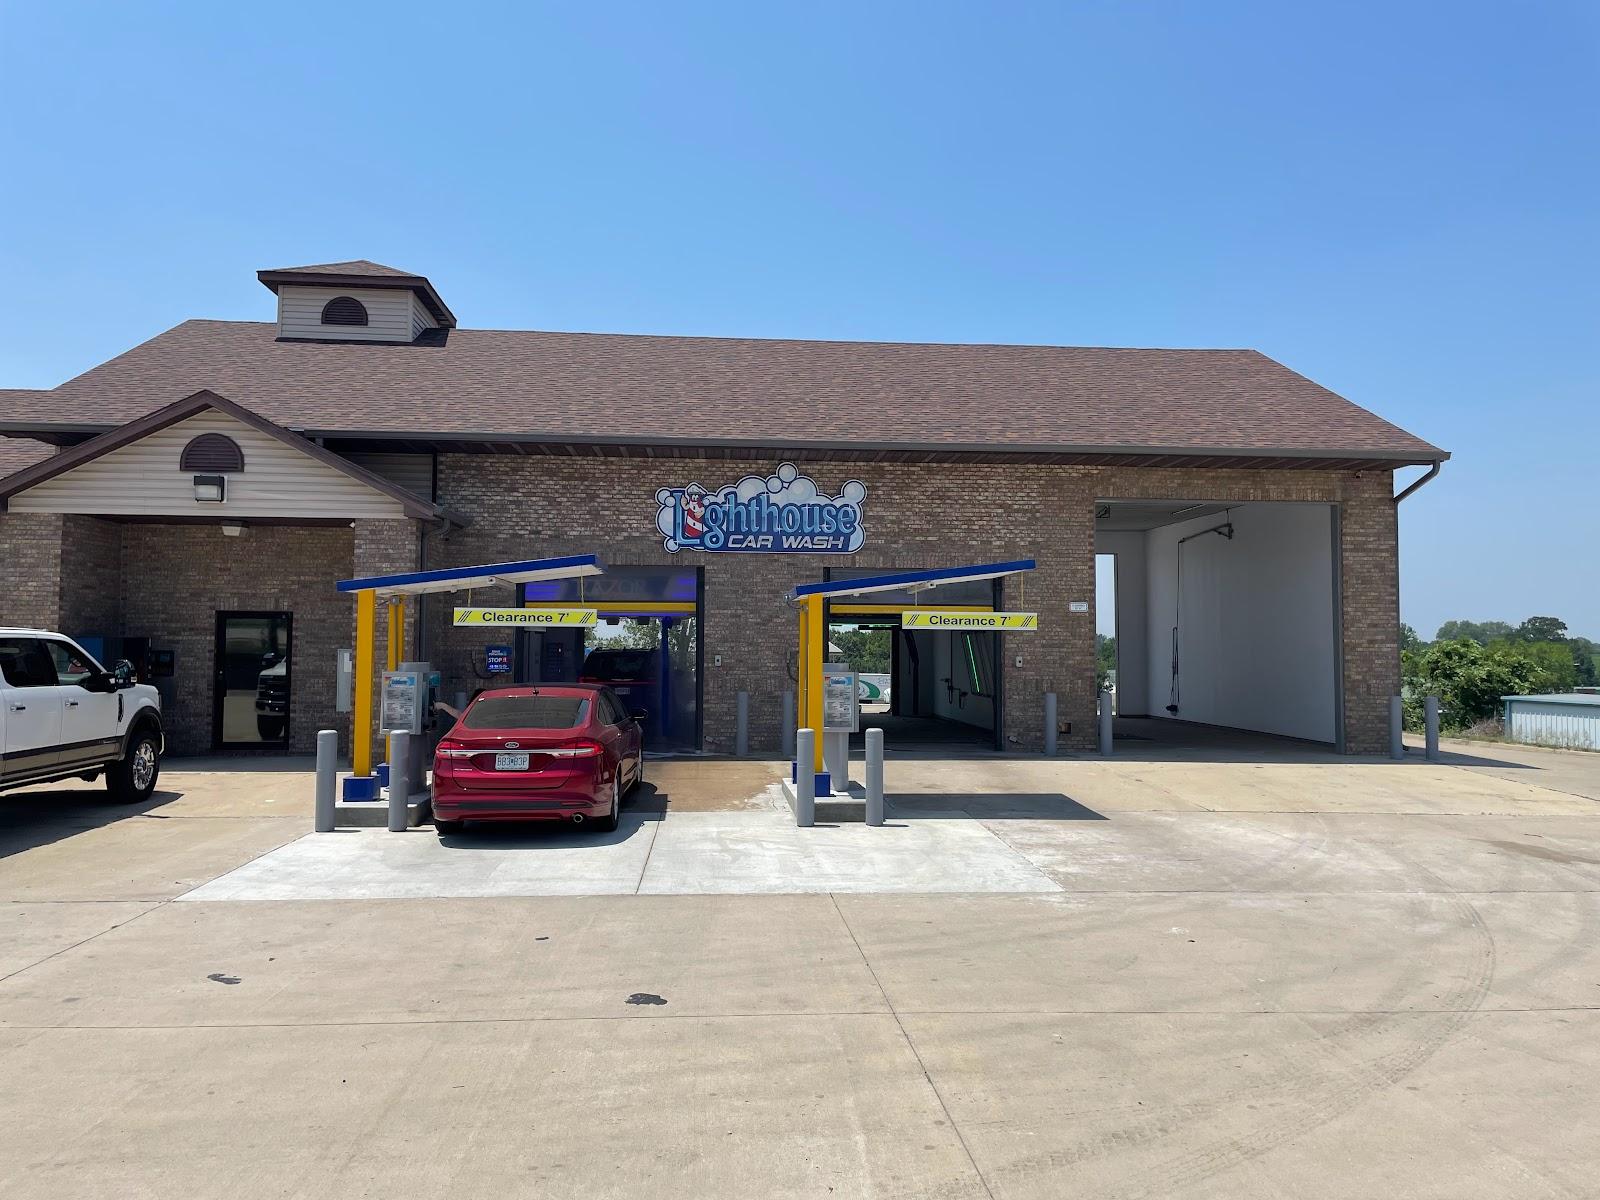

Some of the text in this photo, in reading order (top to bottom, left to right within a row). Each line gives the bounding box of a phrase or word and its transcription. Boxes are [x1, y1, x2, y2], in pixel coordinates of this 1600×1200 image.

[728, 534, 845, 549] CAR WASH
[482, 611, 570, 623] Clearance 7'
[929, 615, 1011, 626] Clearance 7'
